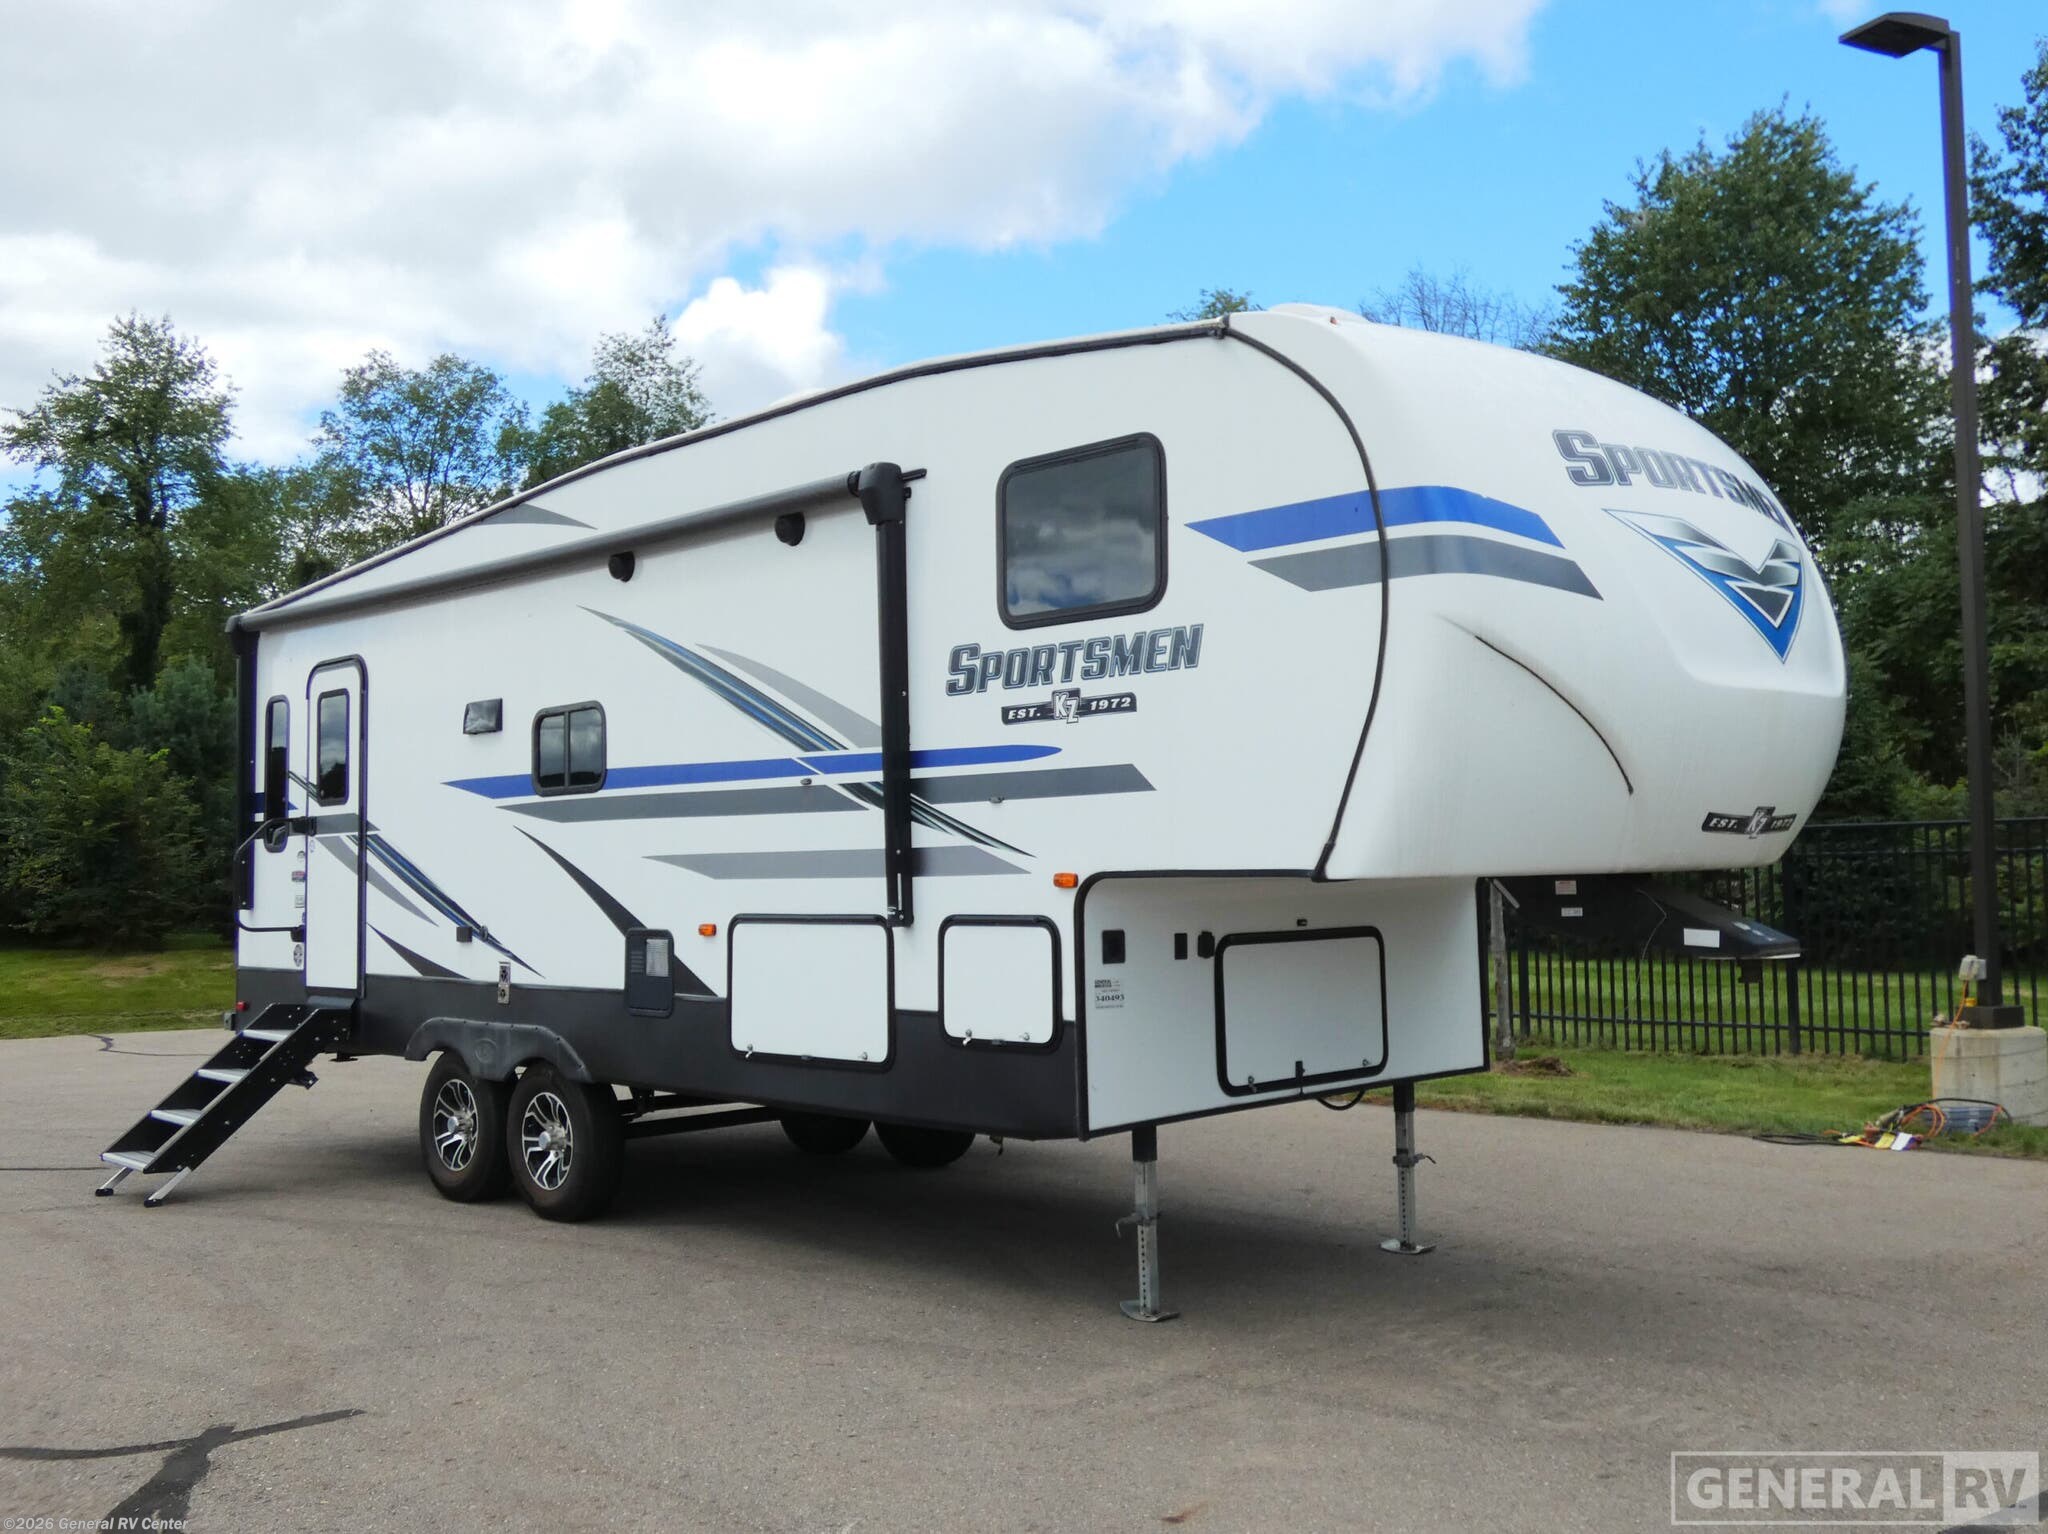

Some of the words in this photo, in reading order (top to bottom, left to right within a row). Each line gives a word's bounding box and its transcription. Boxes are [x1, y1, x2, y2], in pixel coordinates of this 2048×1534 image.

[945, 623, 1204, 696] SPORTSMEN
[1007, 707, 1041, 720] EST.
[1053, 691, 1080, 724] KZ
[1090, 697, 1131, 711] 1972
[1708, 817, 1739, 829] EST.
